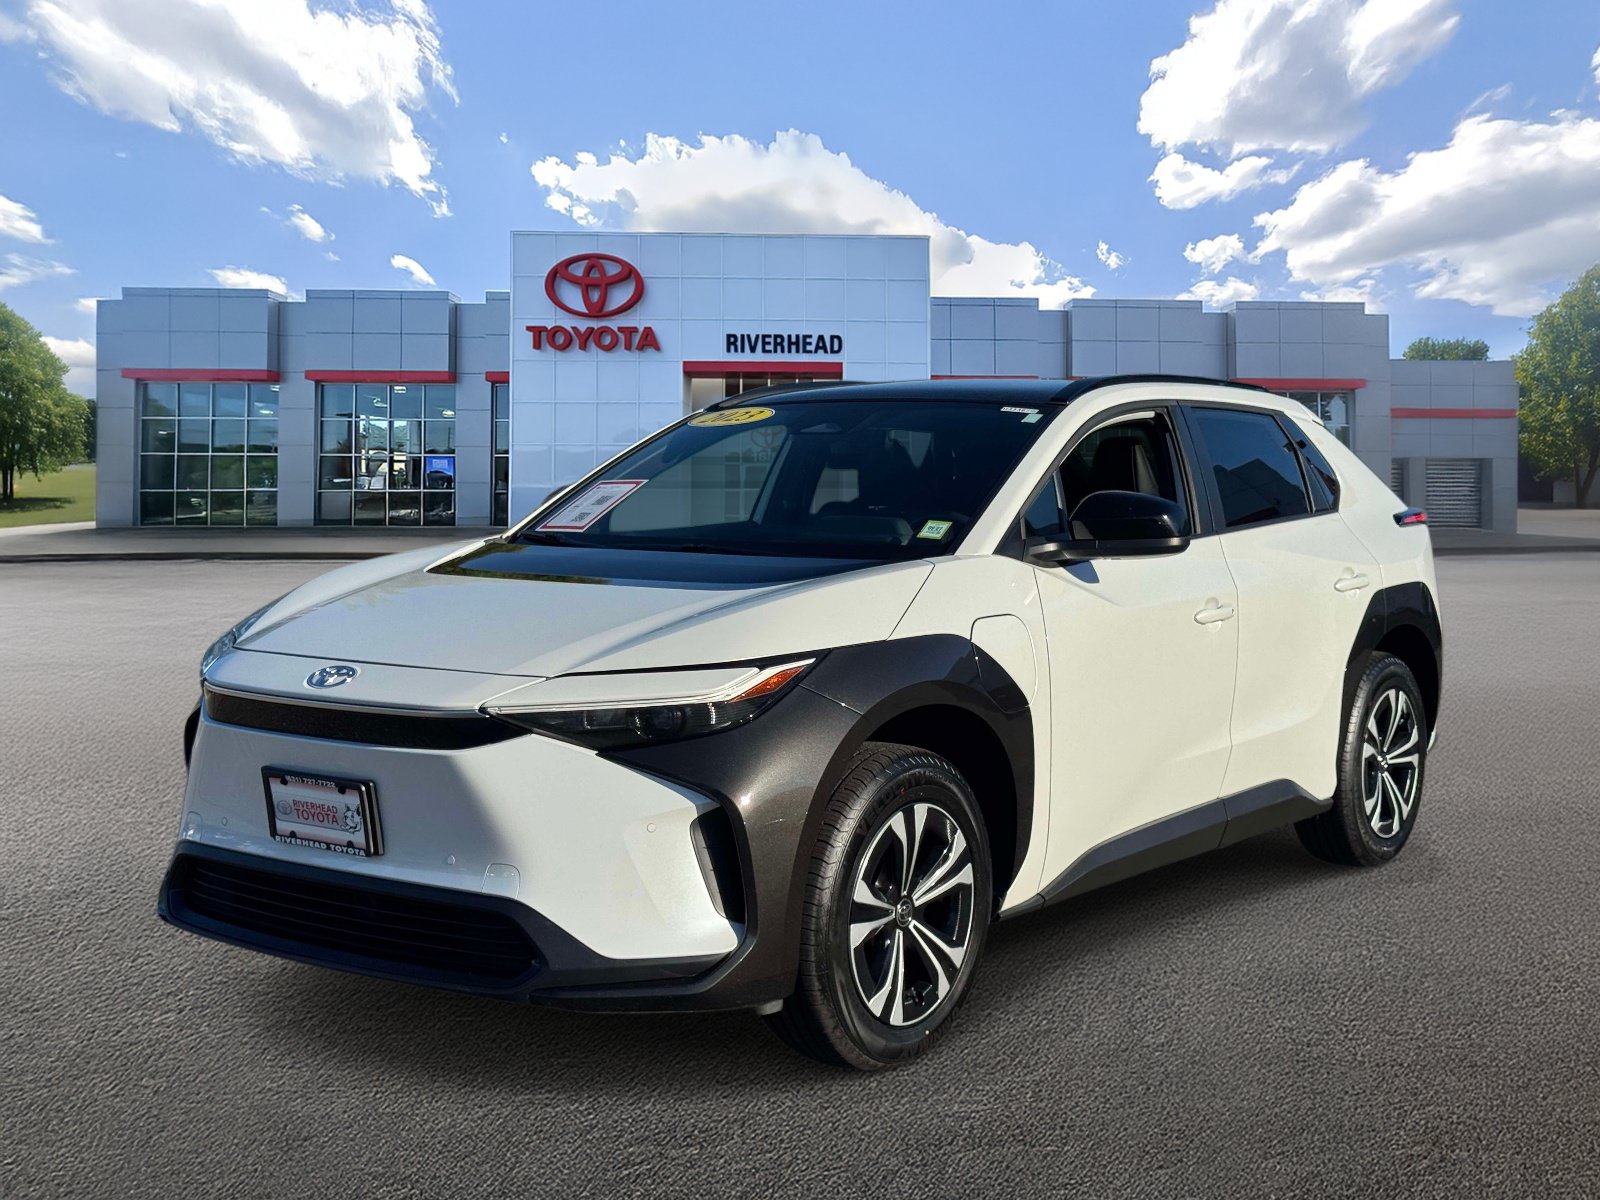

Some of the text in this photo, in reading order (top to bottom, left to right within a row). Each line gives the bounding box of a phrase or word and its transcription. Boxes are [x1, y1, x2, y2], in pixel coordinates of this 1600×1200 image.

[525, 325, 661, 351] TOYOTA
[725, 333, 843, 354] RIVERHEAD
[293, 799, 338, 814] RIVERHEAD
[294, 808, 340, 826] TOYOTA
[275, 835, 366, 857] RIVERHEAD TOYOTA
